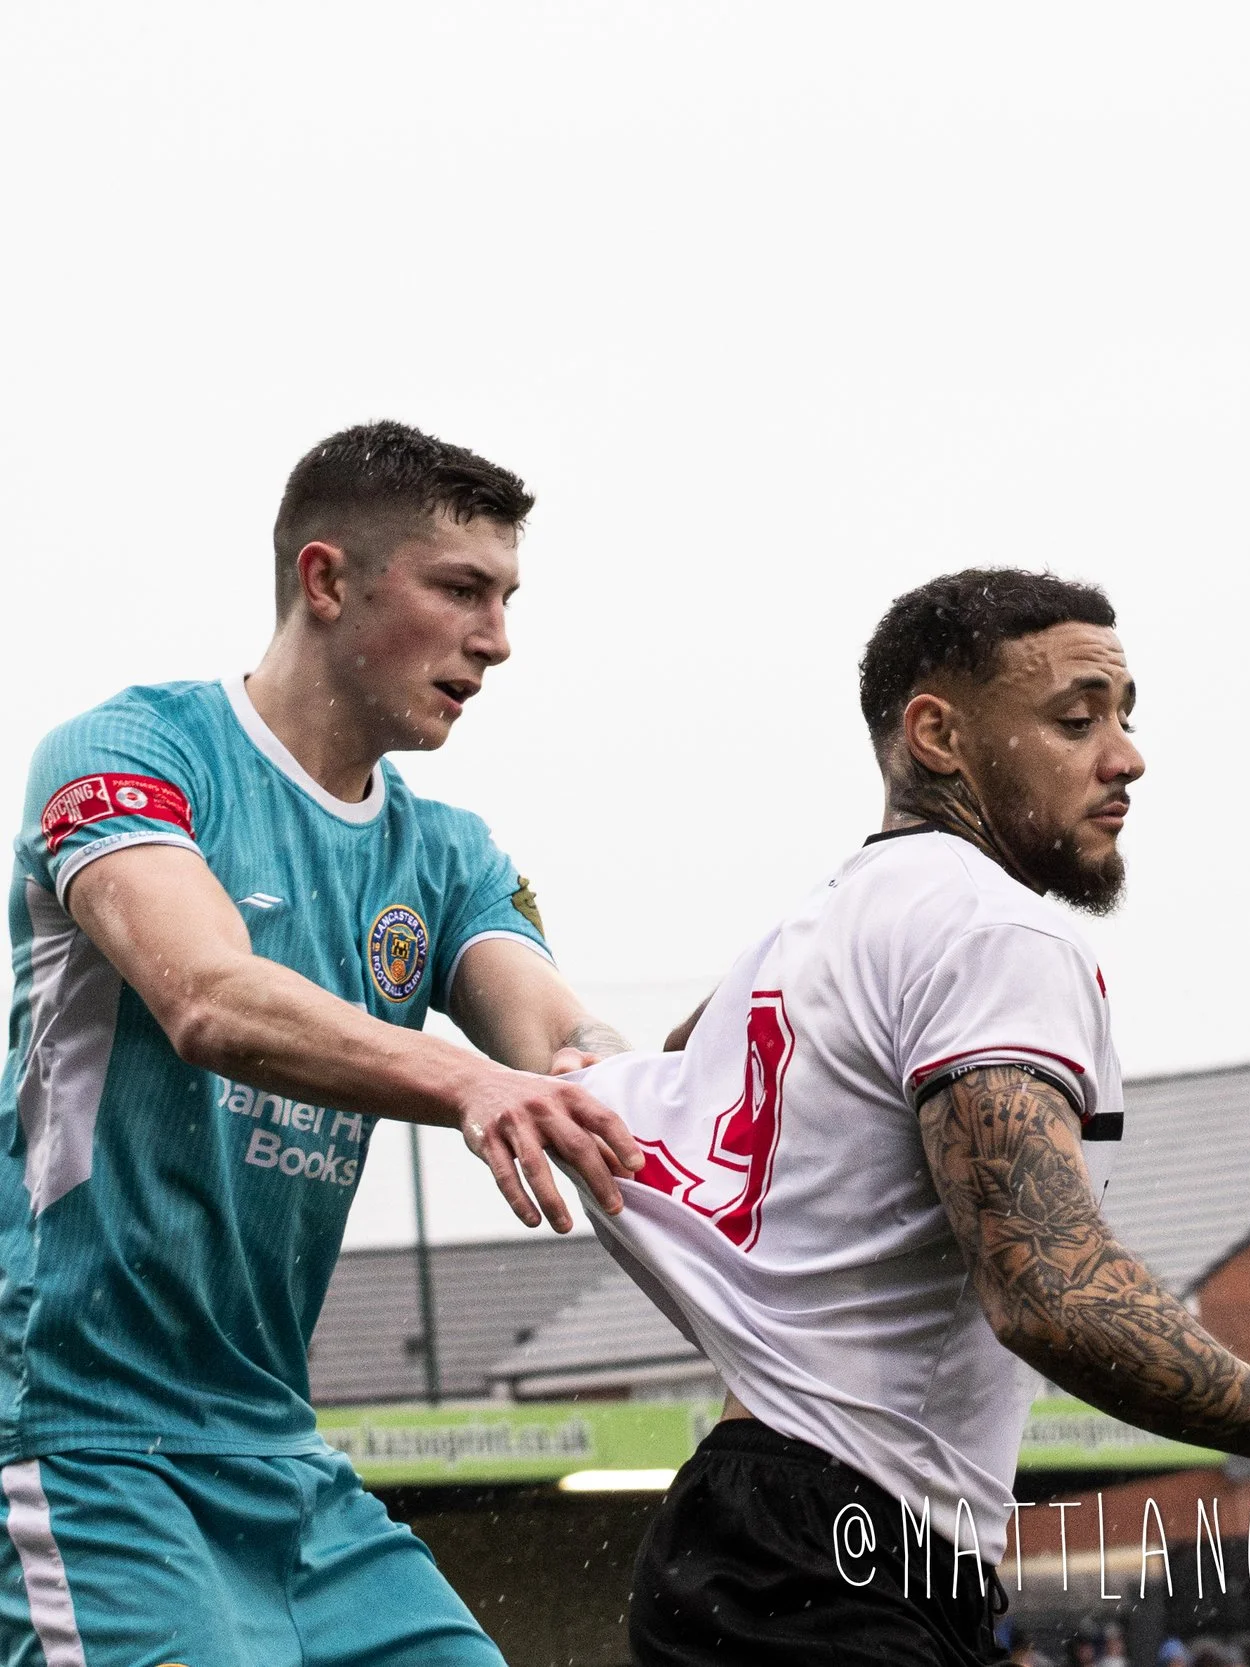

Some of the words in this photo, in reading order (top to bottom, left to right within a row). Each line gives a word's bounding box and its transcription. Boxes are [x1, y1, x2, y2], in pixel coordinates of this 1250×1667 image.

[47, 783, 94, 829] PITCHING
[374, 910, 418, 939] LANCASTER
[416, 929, 426, 955] CITY
[372, 956, 403, 996] FOOTBALL
[244, 1127, 358, 1186] Books
